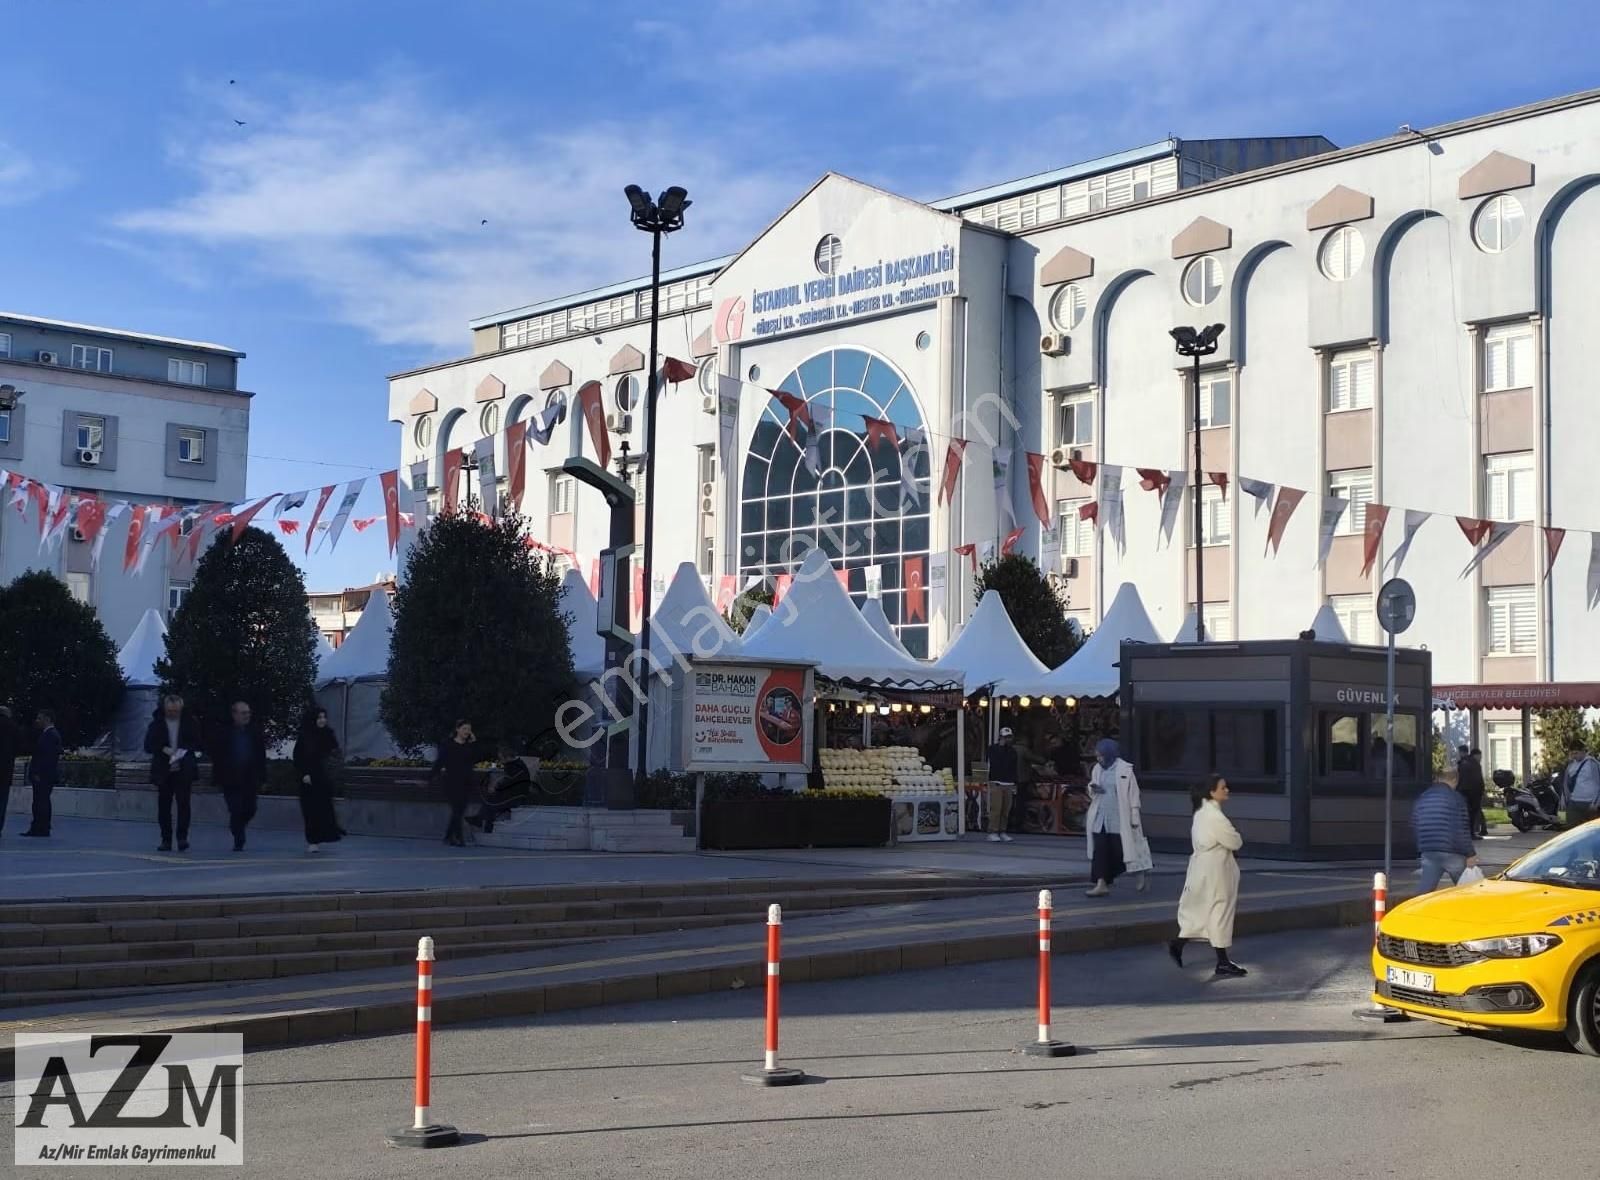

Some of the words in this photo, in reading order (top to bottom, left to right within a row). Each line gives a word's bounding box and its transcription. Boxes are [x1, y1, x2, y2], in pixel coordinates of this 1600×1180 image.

[753, 285, 801, 314] İSTANBUL
[804, 273, 835, 302] VERGİ
[838, 259, 882, 295] DAİRESİ
[885, 244, 954, 286] BAŞKANLIĞI
[712, 673, 726, 683] DR.
[728, 674, 756, 684] HAKAN
[711, 683, 756, 694] BAHADIR
[1336, 688, 1400, 705] GÜVENLK
[695, 704, 719, 713] DAHA
